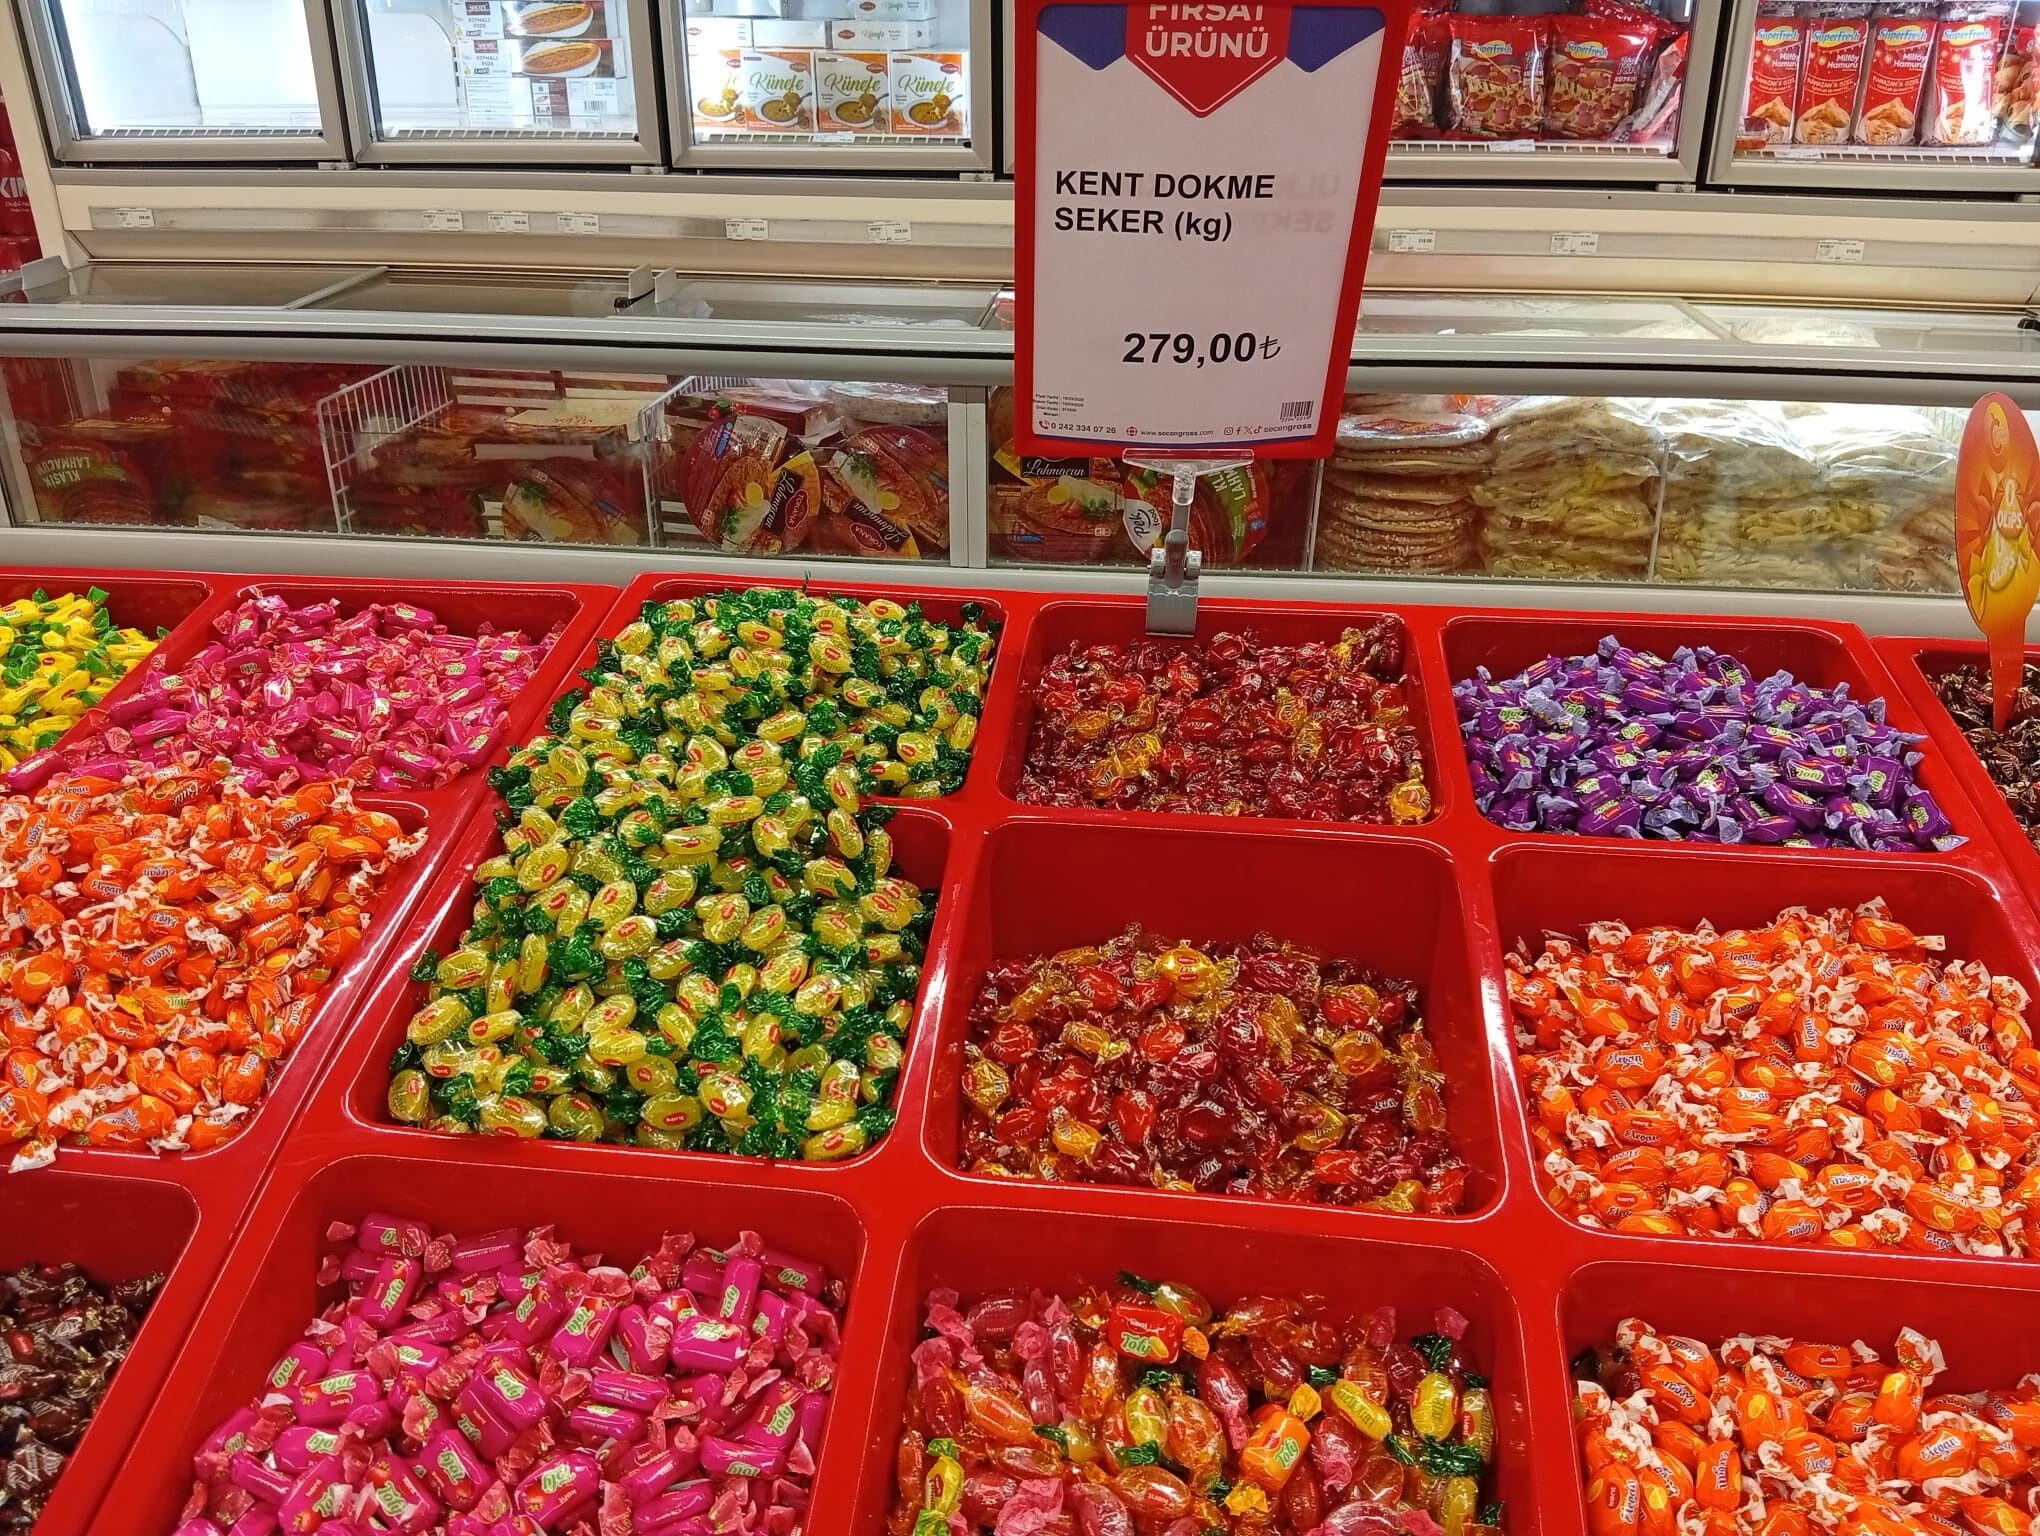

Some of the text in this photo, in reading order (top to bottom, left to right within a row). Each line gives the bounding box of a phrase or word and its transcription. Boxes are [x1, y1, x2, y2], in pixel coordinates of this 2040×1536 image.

[1145, 25, 1269, 58] ÜRÜNÜ
[750, 72, 804, 95] Künefe
[824, 72, 881, 95] Künefe
[898, 72, 954, 95] Künefe
[1056, 170, 1275, 199] KENT DOKME
[1054, 207, 1232, 242] SEKER (kg)
[1058, 423, 1074, 431] 242
[1076, 424, 1091, 432] 334
[1093, 425, 1104, 433] 07
[1106, 426, 1116, 434] 26
[1141, 429, 1214, 438] www.secengross.com
[1263, 423, 1312, 434] secengross
[1023, 459, 1086, 478] Lahmacun
[1224, 469, 1247, 500] LAHM
